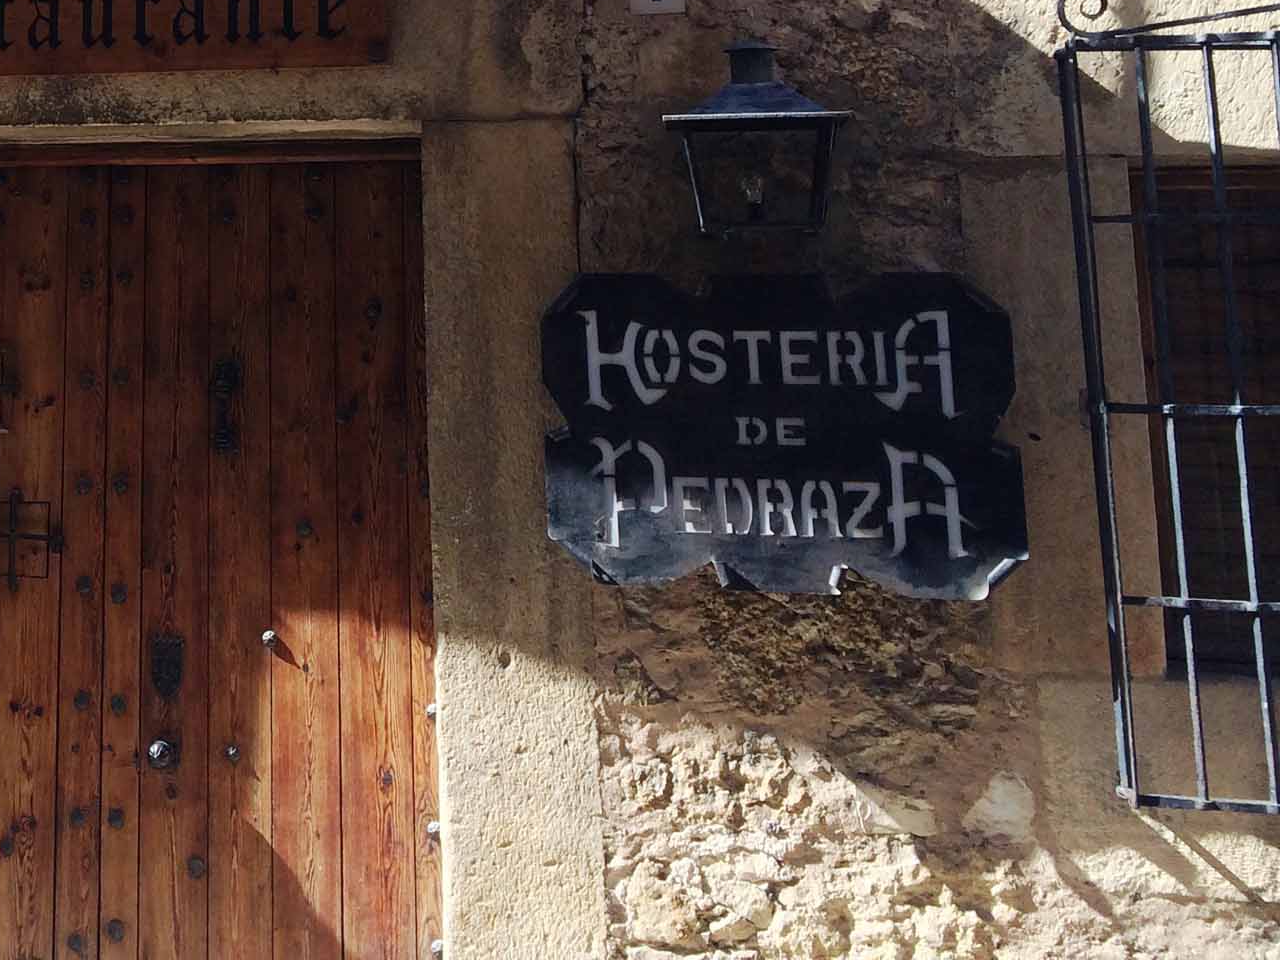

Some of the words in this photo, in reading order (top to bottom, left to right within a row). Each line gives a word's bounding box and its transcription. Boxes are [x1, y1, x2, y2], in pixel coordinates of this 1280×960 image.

[576, 309, 962, 420] HOSTERIA
[736, 416, 807, 446] DE
[591, 437, 977, 558] PEDRAZA
